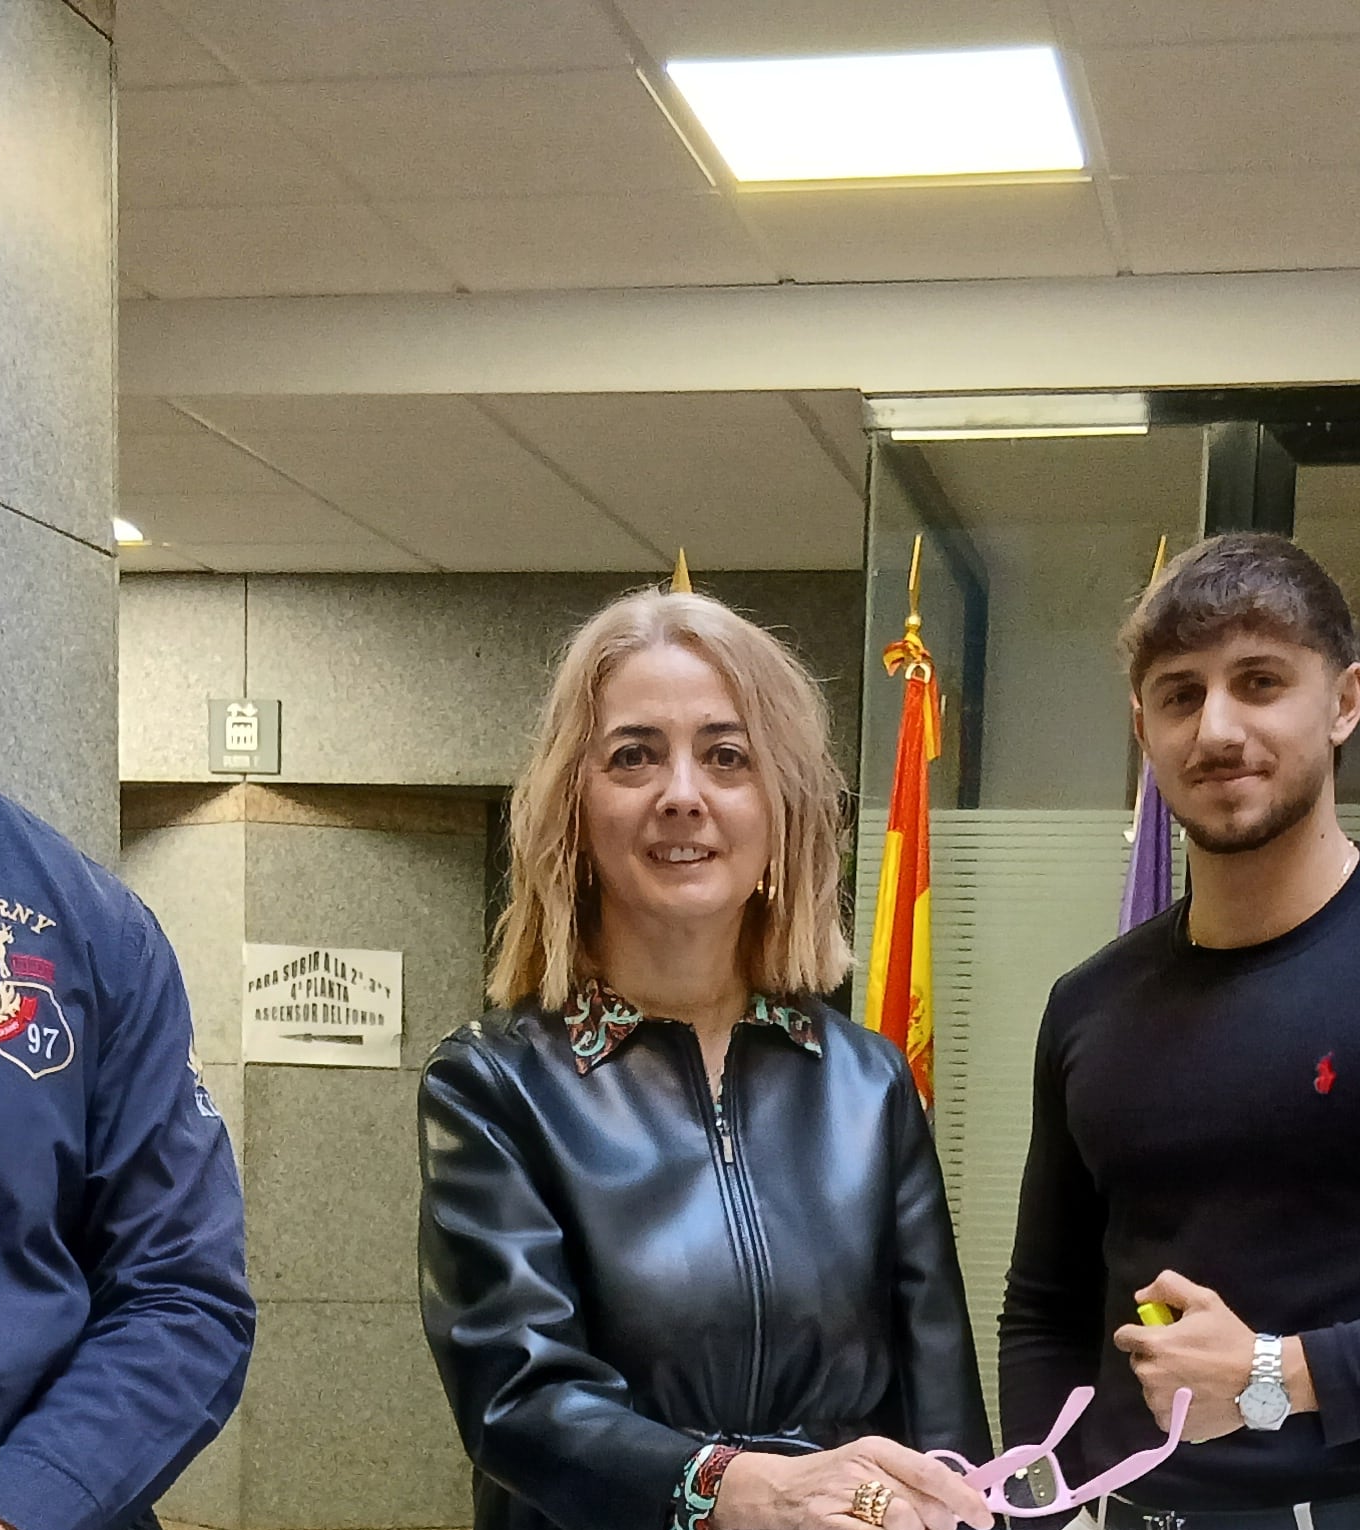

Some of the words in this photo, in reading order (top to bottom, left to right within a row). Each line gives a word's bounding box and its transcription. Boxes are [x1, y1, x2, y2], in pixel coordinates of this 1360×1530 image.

[248, 969, 278, 992] PARA
[283, 951, 319, 981] SUBIR
[324, 952, 330, 973] A
[335, 958, 347, 981] LA
[306, 977, 349, 1002] PLANTA
[255, 1003, 318, 1023] ASCENSOR
[323, 1003, 341, 1024] DEL
[27, 1023, 59, 1059] 97
